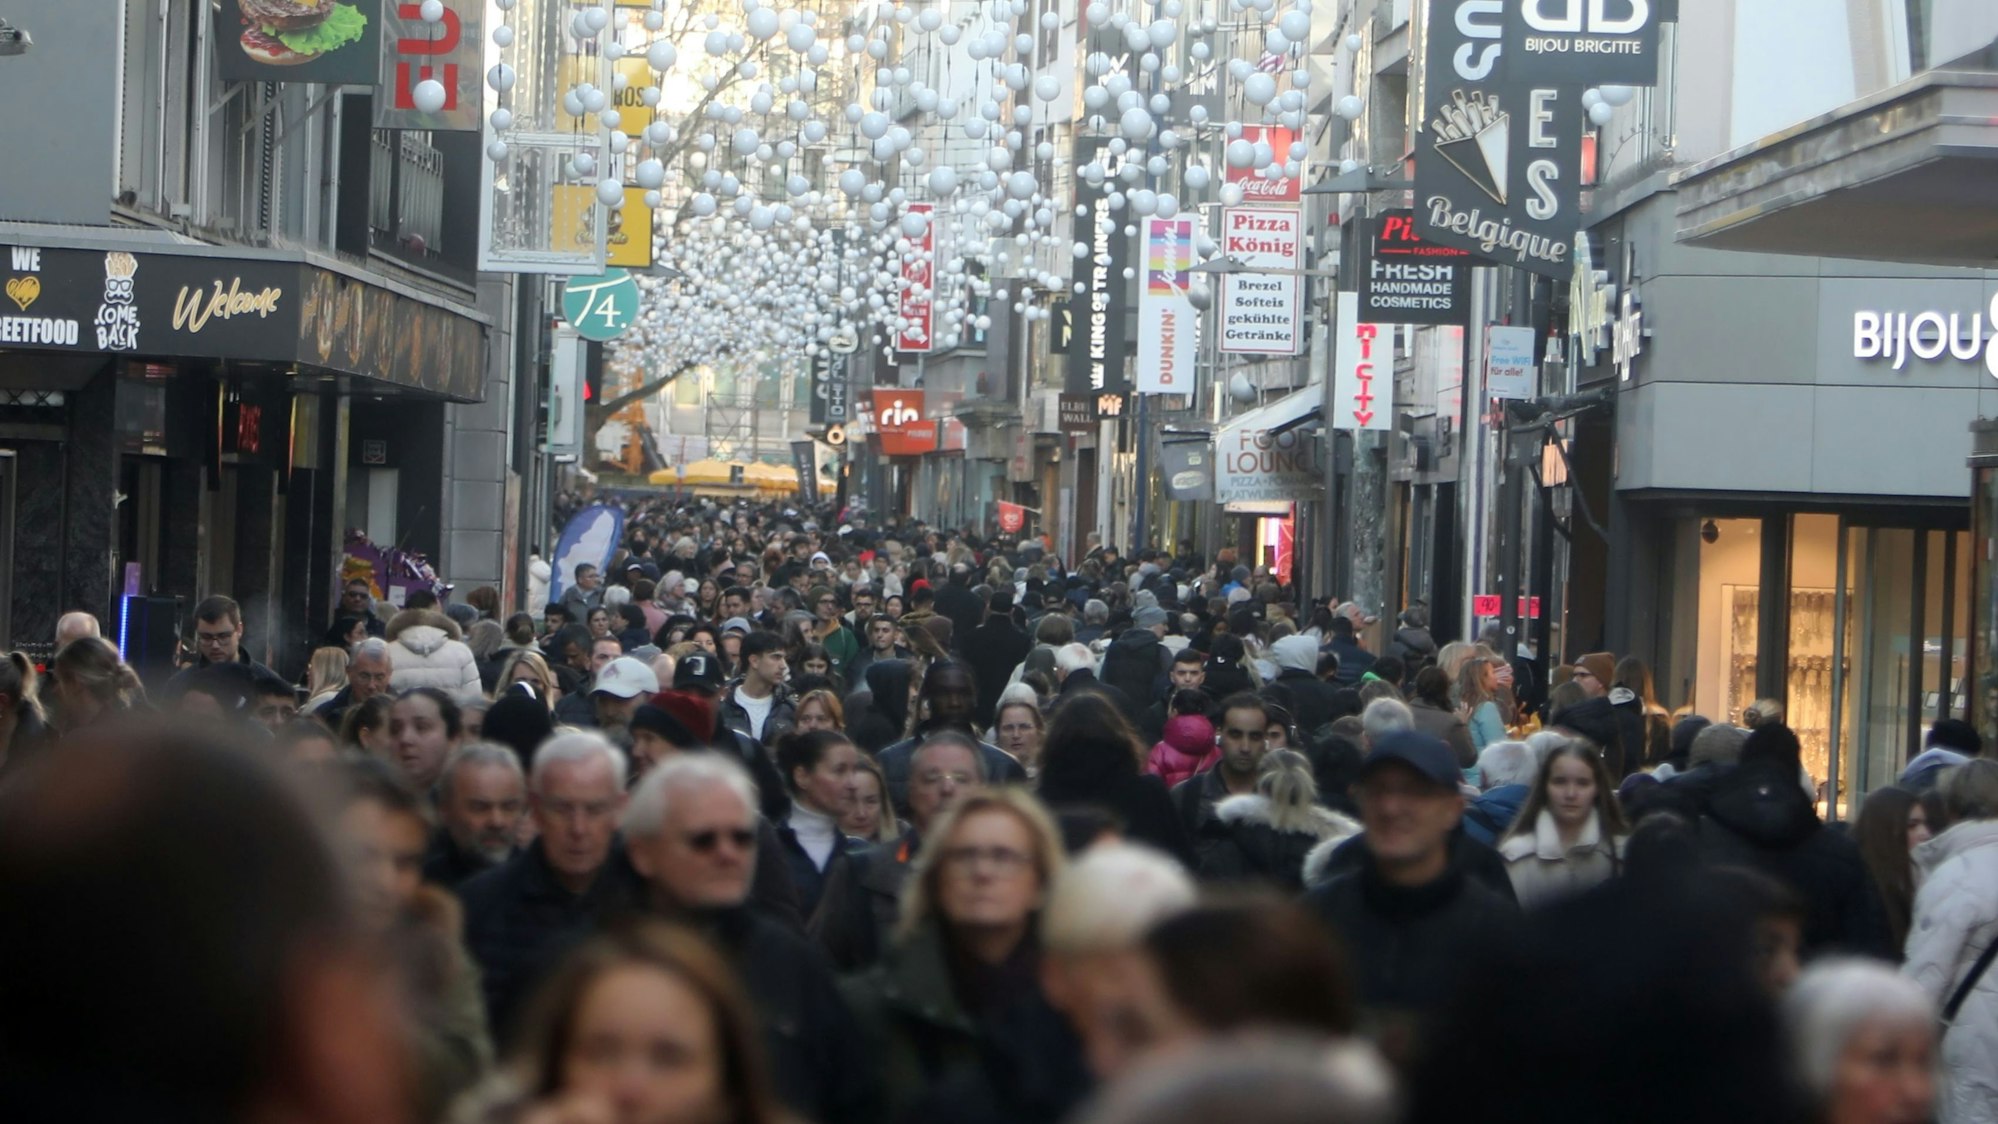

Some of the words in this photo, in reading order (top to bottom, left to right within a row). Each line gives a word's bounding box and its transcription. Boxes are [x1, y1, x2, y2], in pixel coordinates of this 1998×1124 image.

[1525, 38, 1569, 55] BIJOU
[1574, 38, 1642, 55] BRIGITTE
[1233, 214, 1290, 232] Pizza
[1380, 216, 1421, 241] Pi
[1426, 193, 1567, 263] Belgique
[1228, 236, 1295, 258] König
[1413, 247, 1459, 256] FASHION
[11, 246, 41, 271] WE
[1371, 259, 1453, 280] FRESH
[1238, 280, 1282, 291] Brezel
[1371, 282, 1452, 295] HANDMADE
[172, 277, 282, 333] Welcome
[1235, 296, 1284, 308] Softeis
[1371, 296, 1452, 309] COSMETICS
[97, 303, 138, 329] COME
[1227, 314, 1290, 325] gekühlte
[0, 316, 79, 345] EETFOOD
[96, 324, 139, 350] BACK
[1090, 314, 1107, 359] KING
[1225, 329, 1292, 341] Getränke
[1853, 310, 1981, 370] BIJOU
[1159, 309, 1175, 385] DUNKIN'
[1491, 355, 1510, 364] Free
[1490, 367, 1502, 375] für
[1504, 367, 1524, 377] alle!
[1231, 475, 1262, 487] PIZZA
